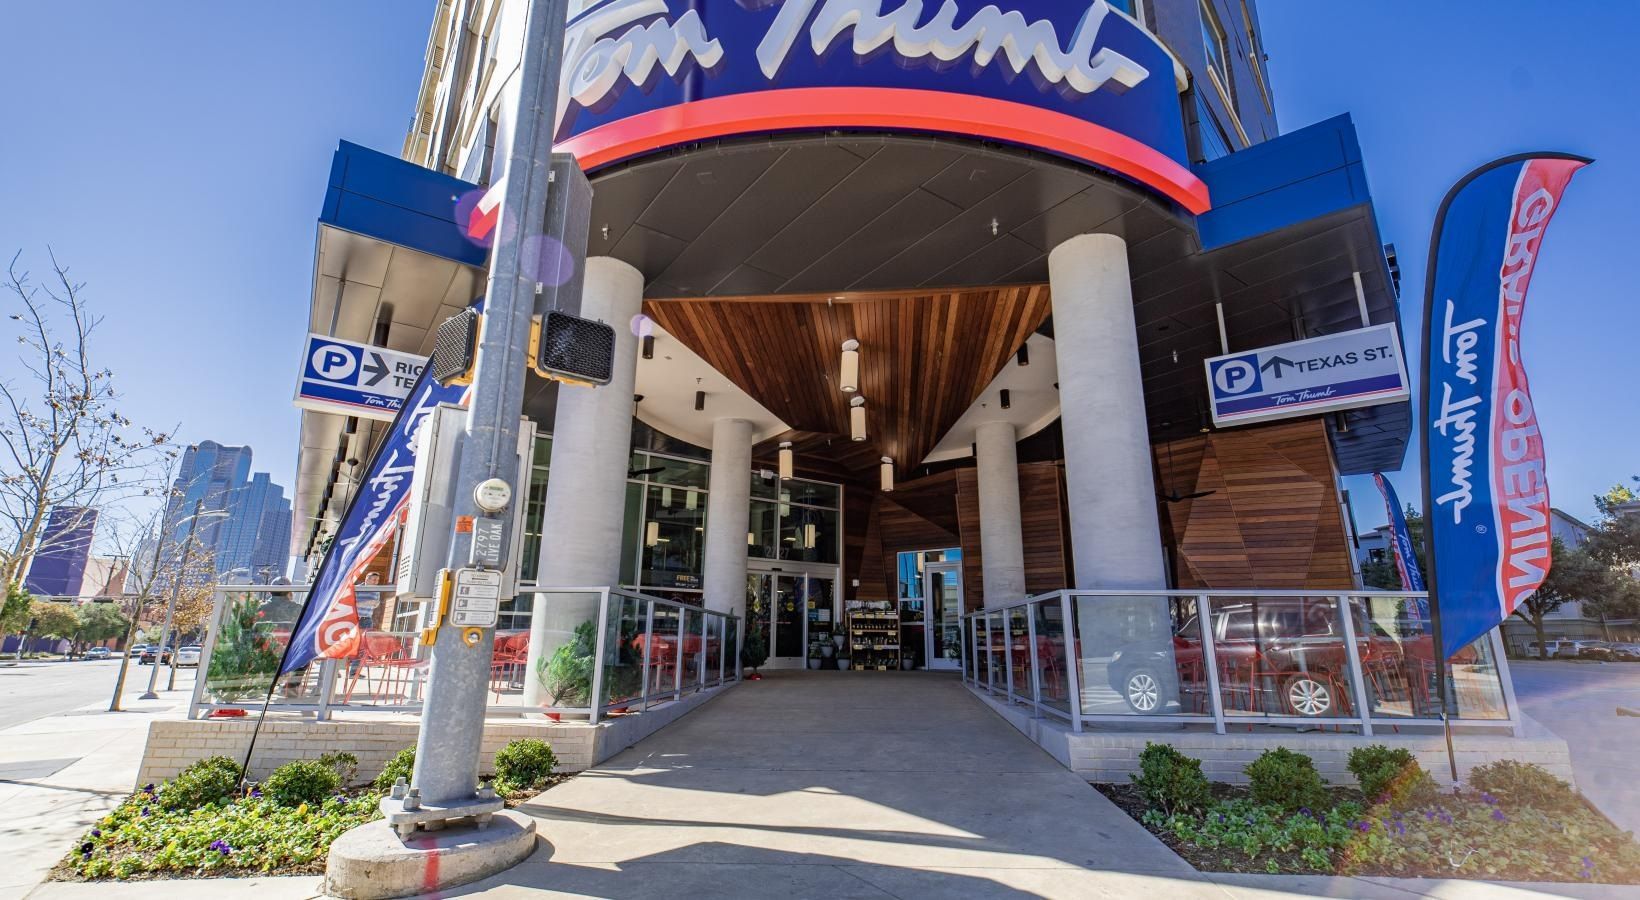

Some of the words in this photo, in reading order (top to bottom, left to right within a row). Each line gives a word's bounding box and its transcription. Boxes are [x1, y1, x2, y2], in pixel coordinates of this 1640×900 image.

[555, 0, 725, 124] Tom
[322, 350, 348, 373] P
[1294, 351, 1359, 373] TEXAS
[1364, 345, 1394, 362] ST.
[395, 361, 424, 377] RIG
[1225, 365, 1247, 389] P
[393, 375, 415, 389] TE
[362, 394, 384, 407] Tom
[386, 398, 402, 409] Thu
[1271, 394, 1297, 405] Tom
[1293, 386, 1337, 403] Thumb
[489, 523, 503, 541] OAK
[475, 527, 489, 557] 2797
[487, 543, 501, 562] LIVE
